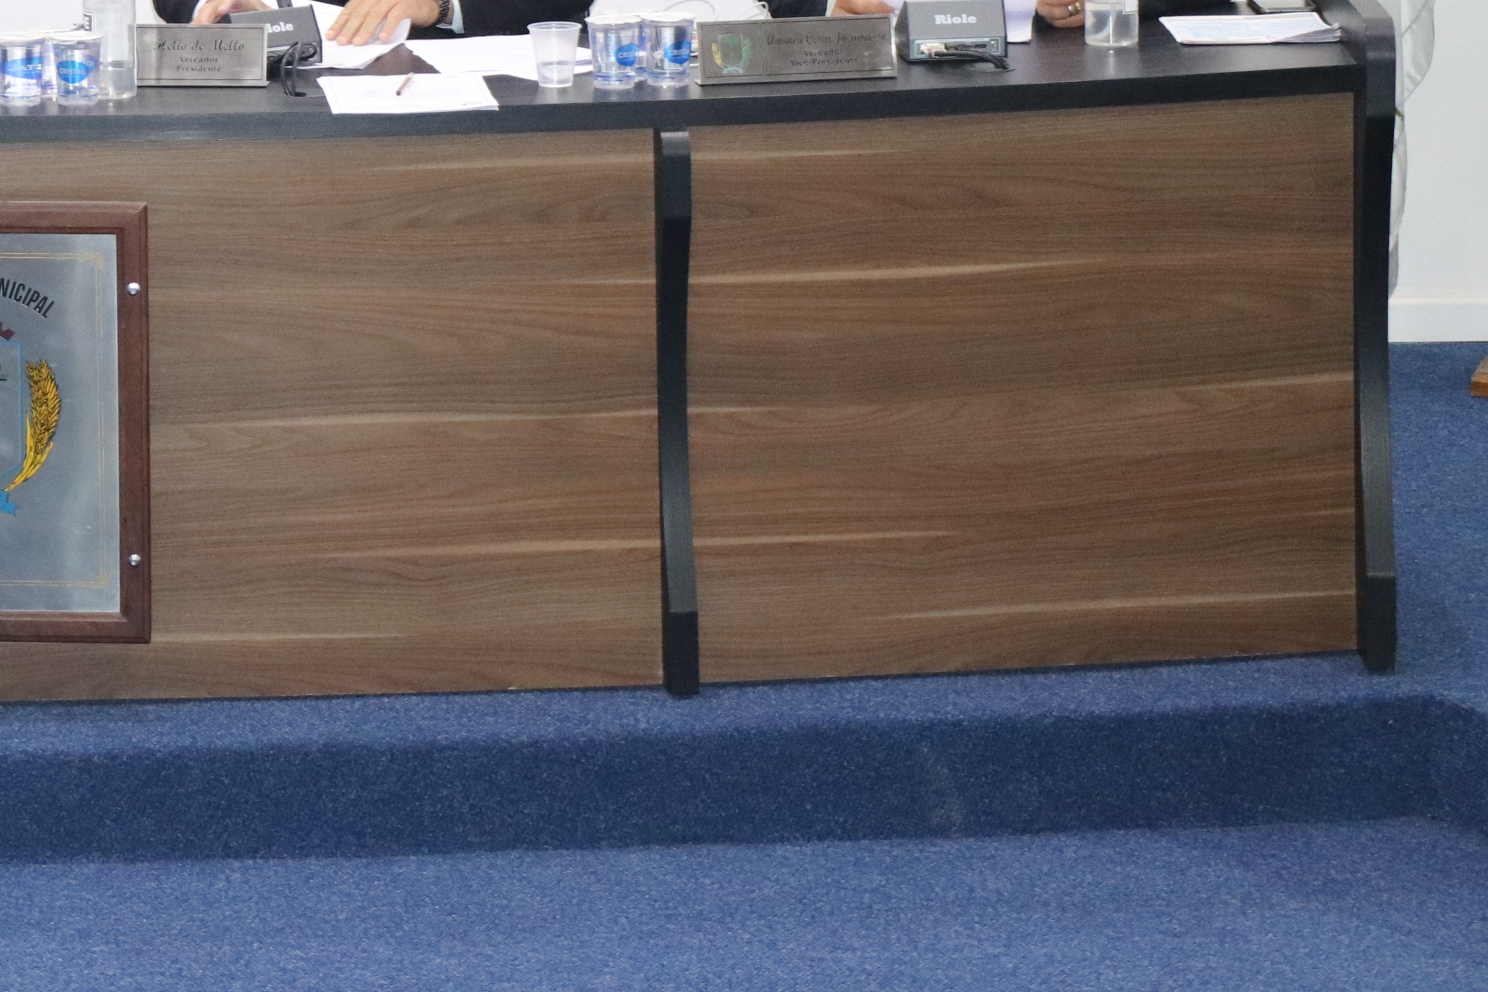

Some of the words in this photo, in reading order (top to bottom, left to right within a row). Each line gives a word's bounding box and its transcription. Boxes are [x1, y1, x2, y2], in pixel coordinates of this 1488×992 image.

[934, 13, 977, 25] Riole
[266, 21, 294, 34] iole
[179, 55, 218, 64] Vereador
[176, 65, 222, 73] Presidente
